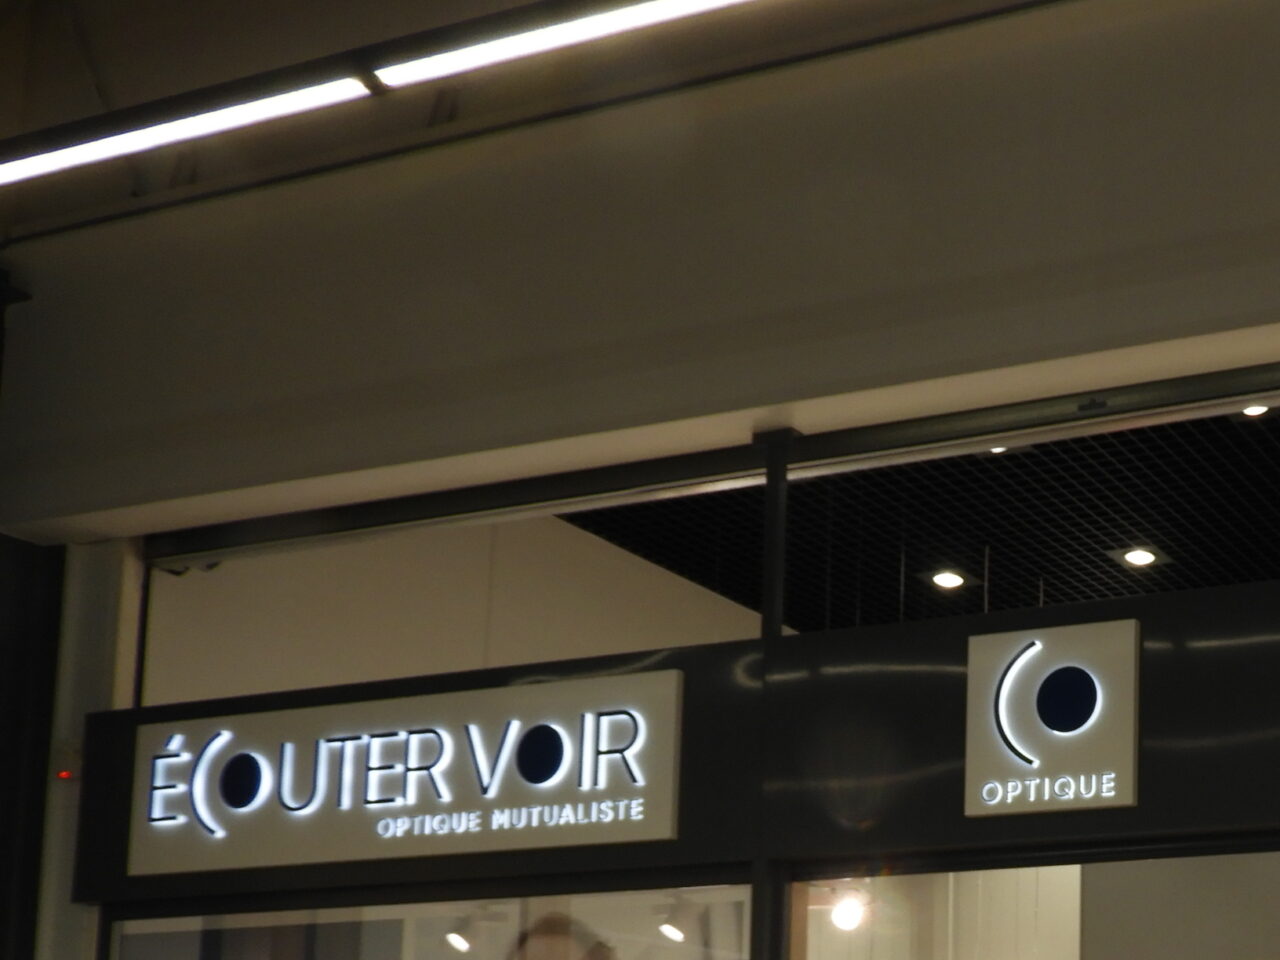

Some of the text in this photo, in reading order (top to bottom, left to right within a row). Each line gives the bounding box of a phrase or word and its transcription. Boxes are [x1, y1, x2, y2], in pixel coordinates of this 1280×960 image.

[147, 709, 646, 838] ÉCOUTER VOIR
[982, 771, 1116, 806] OPTIQUE
[377, 799, 645, 838] OPTIQUE MUTUALISTE
